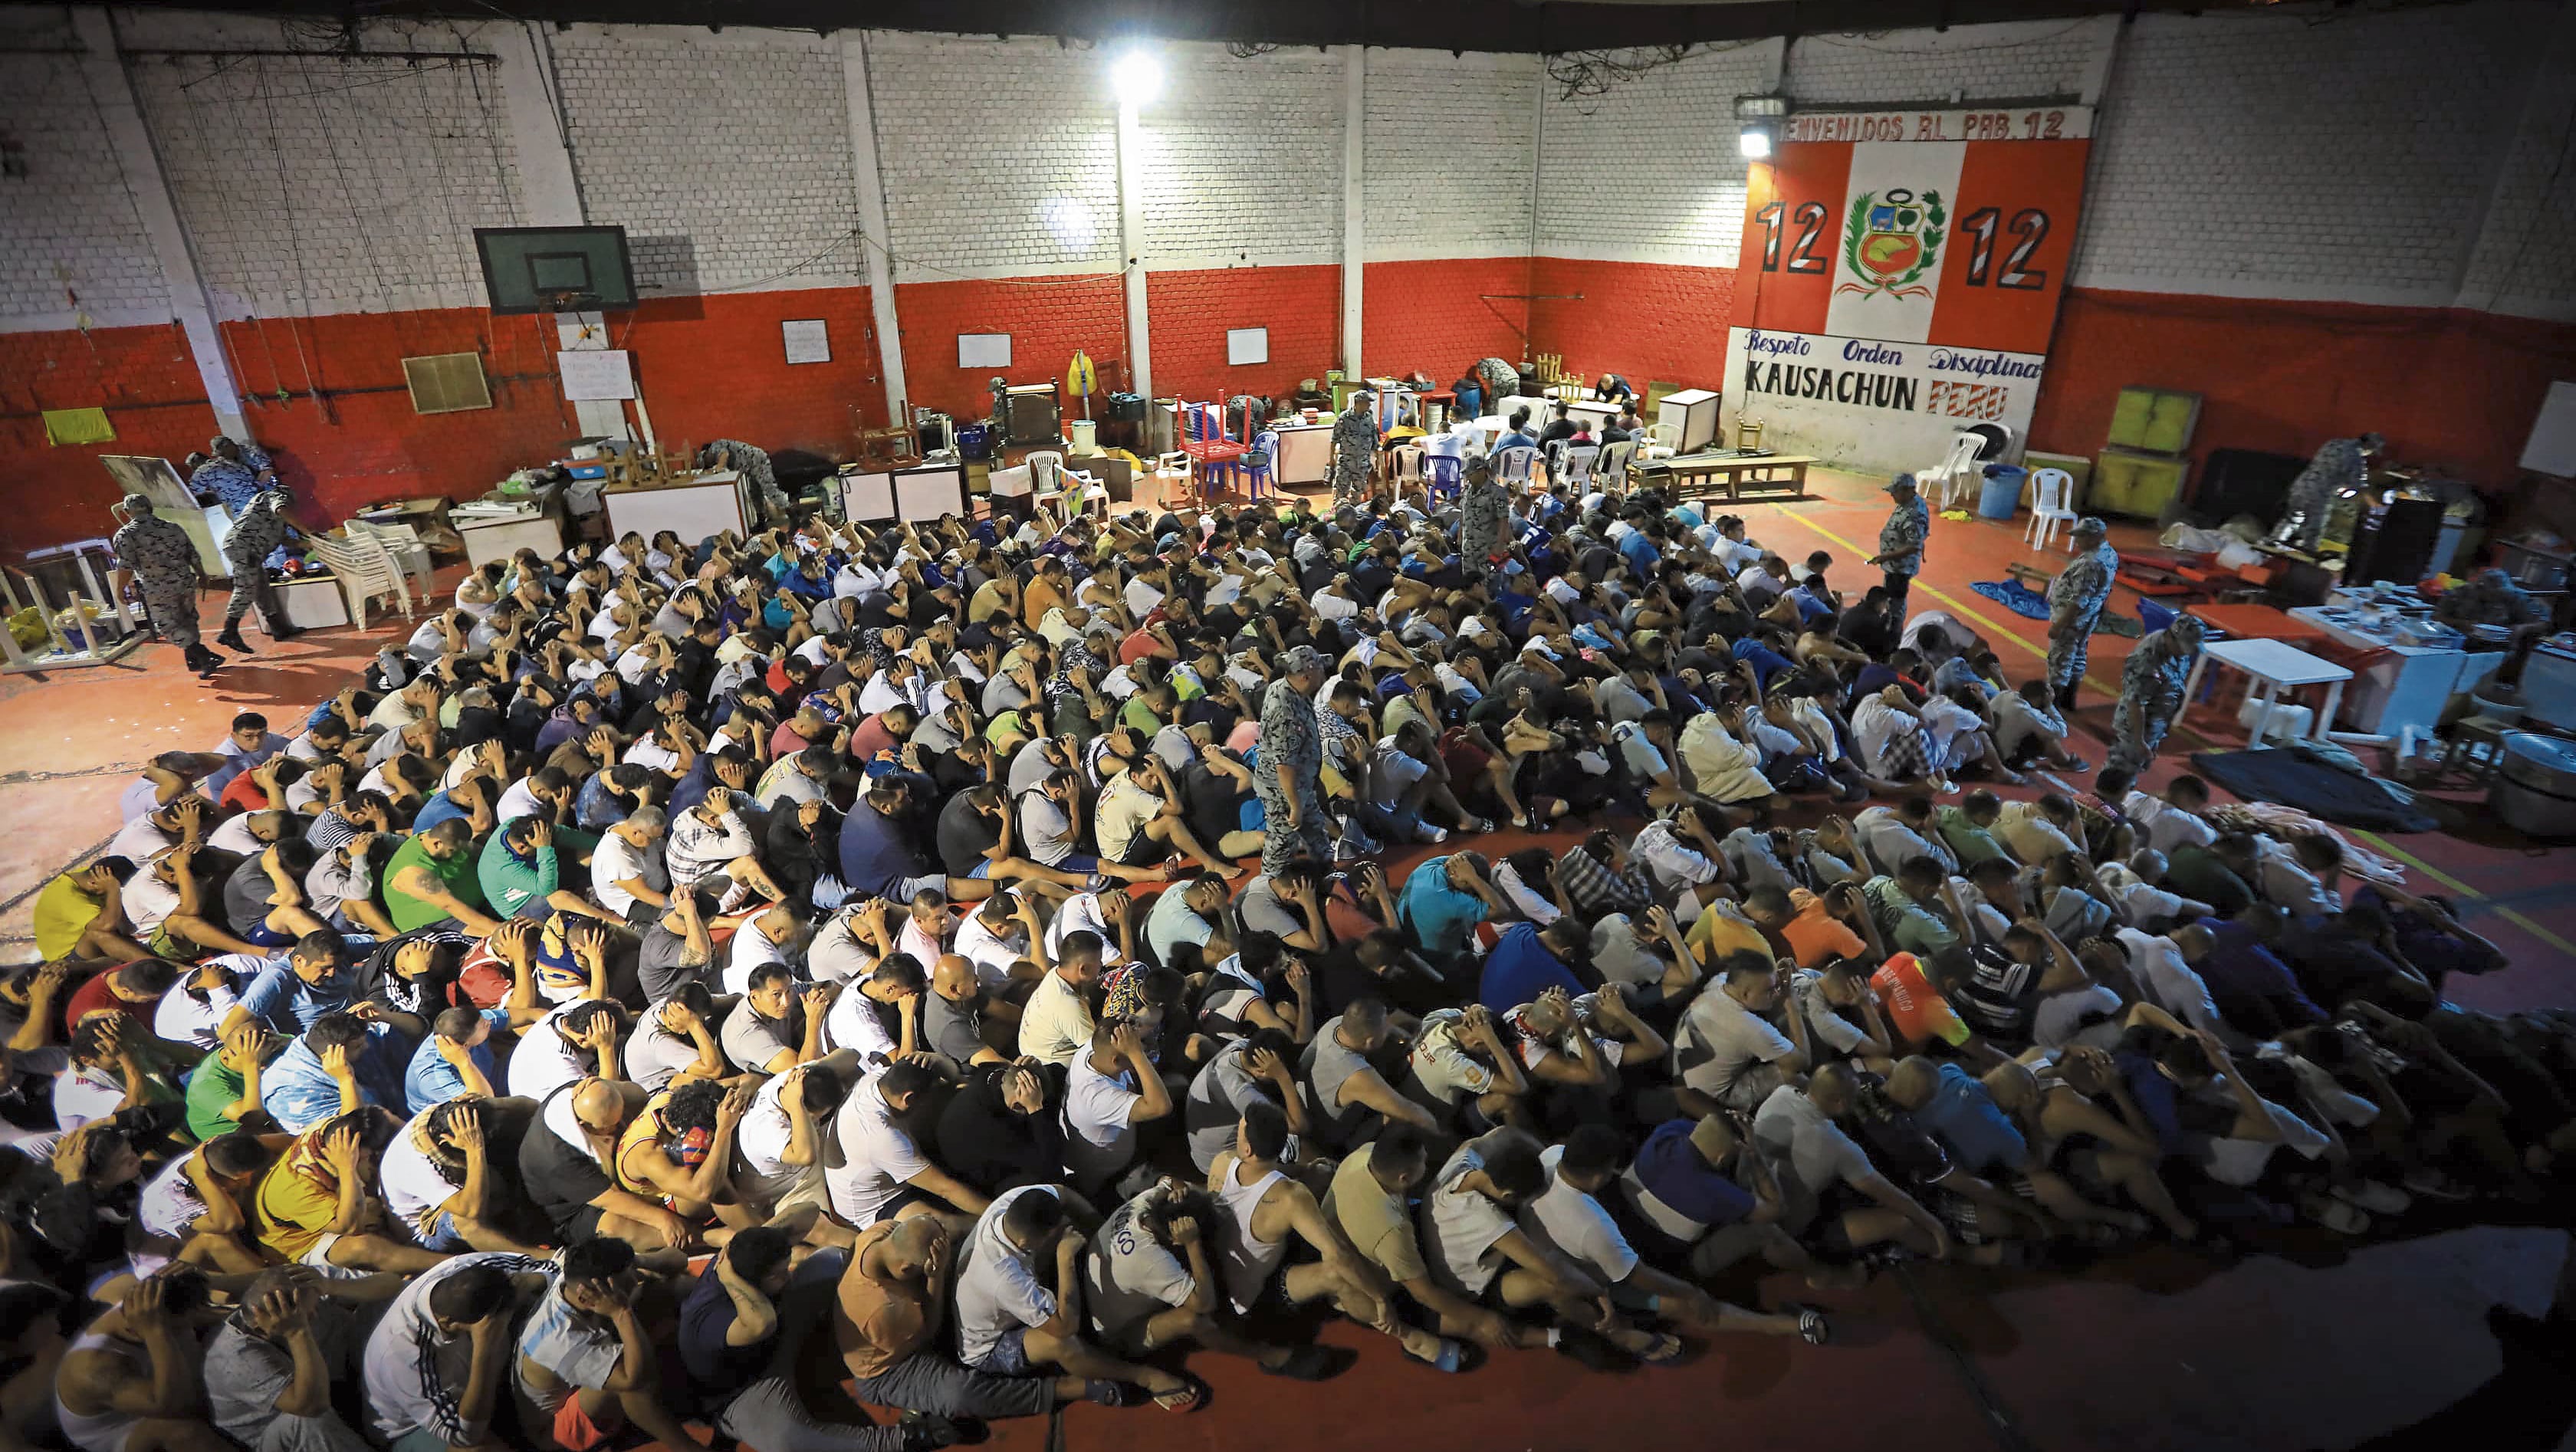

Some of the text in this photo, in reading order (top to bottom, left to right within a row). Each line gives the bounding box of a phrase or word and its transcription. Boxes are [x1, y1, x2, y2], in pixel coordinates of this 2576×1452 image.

[1755, 201, 1828, 275] 12
[1961, 206, 2050, 291] 12
[1744, 330, 2043, 379] Respeto Orden Disciplina
[1746, 360, 2010, 421] KAUSACHUN PERU
